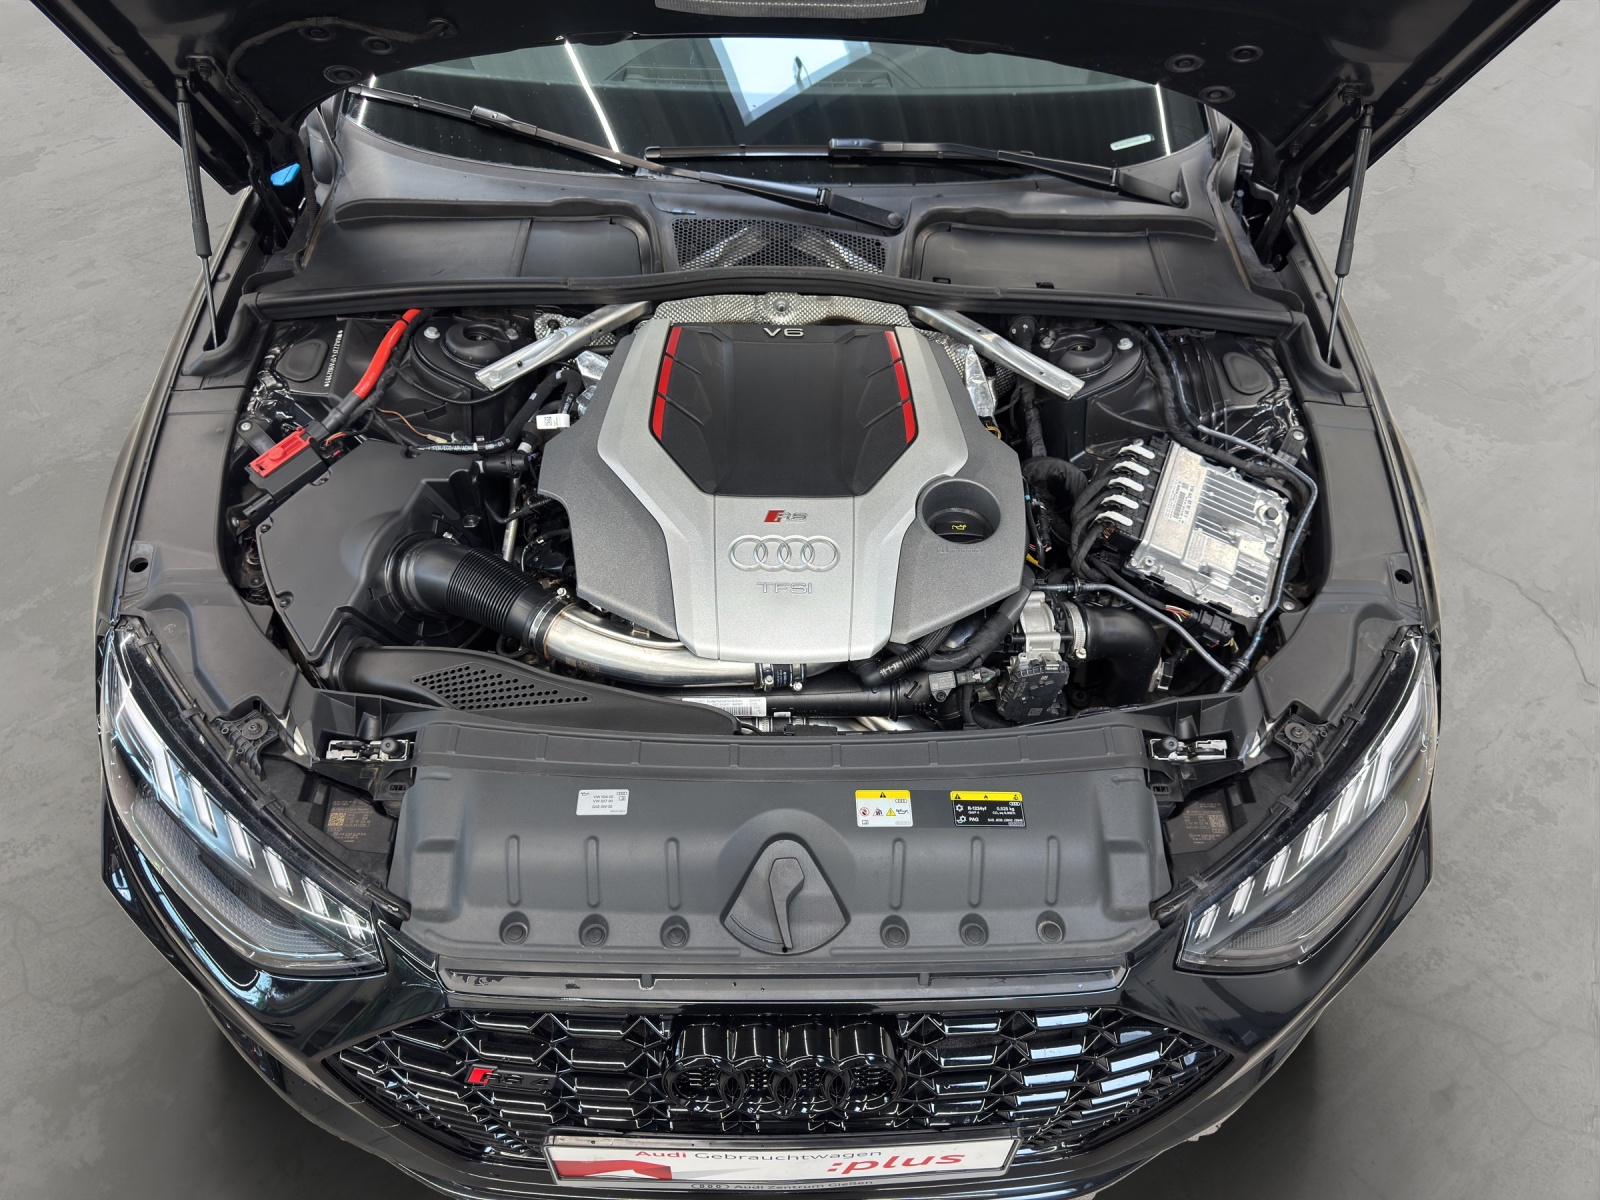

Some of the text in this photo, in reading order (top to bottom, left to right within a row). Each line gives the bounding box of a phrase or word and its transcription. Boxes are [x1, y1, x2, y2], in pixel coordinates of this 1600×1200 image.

[763, 327, 804, 337] V6
[770, 511, 808, 523] RS
[757, 582, 813, 595] TFSI
[694, 1151, 882, 1161] Gebrauchtwagen
